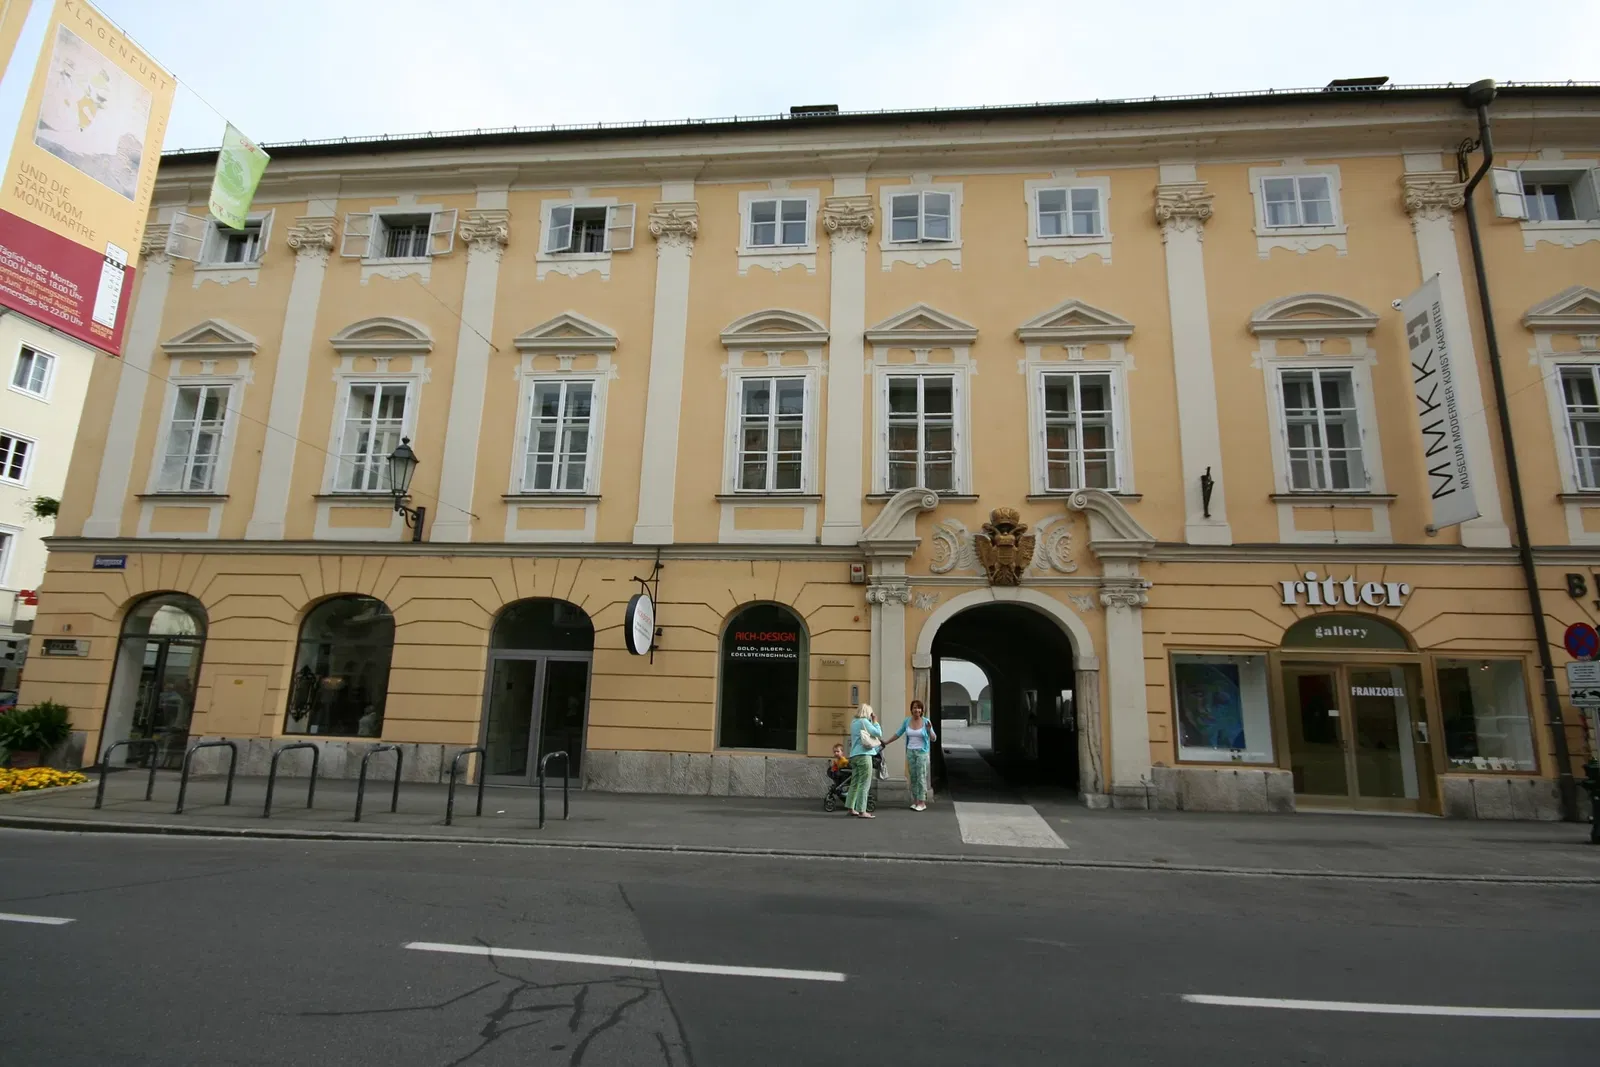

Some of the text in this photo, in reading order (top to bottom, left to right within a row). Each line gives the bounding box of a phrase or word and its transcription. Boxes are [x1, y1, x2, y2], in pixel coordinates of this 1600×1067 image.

[64, 0, 167, 90] KLAGENFURT
[16, 173, 83, 220] STARS VOM
[20, 160, 70, 200] UND DIE
[13, 185, 96, 242] MONTMARTRE
[0, 266, 78, 307] ommeröffnungszeiten
[20, 265, 35, 277] Uhr
[36, 273, 47, 284] bis
[49, 279, 69, 294] 18.00
[24, 286, 37, 297] Juli
[38, 293, 53, 304] und
[27, 260, 49, 275] außer
[50, 271, 78, 292] Montag
[38, 302, 49, 312] bis
[50, 306, 70, 321] 22.00
[70, 316, 84, 327] Uhr
[1432, 300, 1470, 490] MUSEUM MODERNER KUNST KAERNTEN
[1412, 348, 1456, 500] MMKK
[1279, 571, 1410, 607] ritter
[1315, 626, 1368, 638] gallery
[1351, 686, 1404, 697] FRANZOBEL
